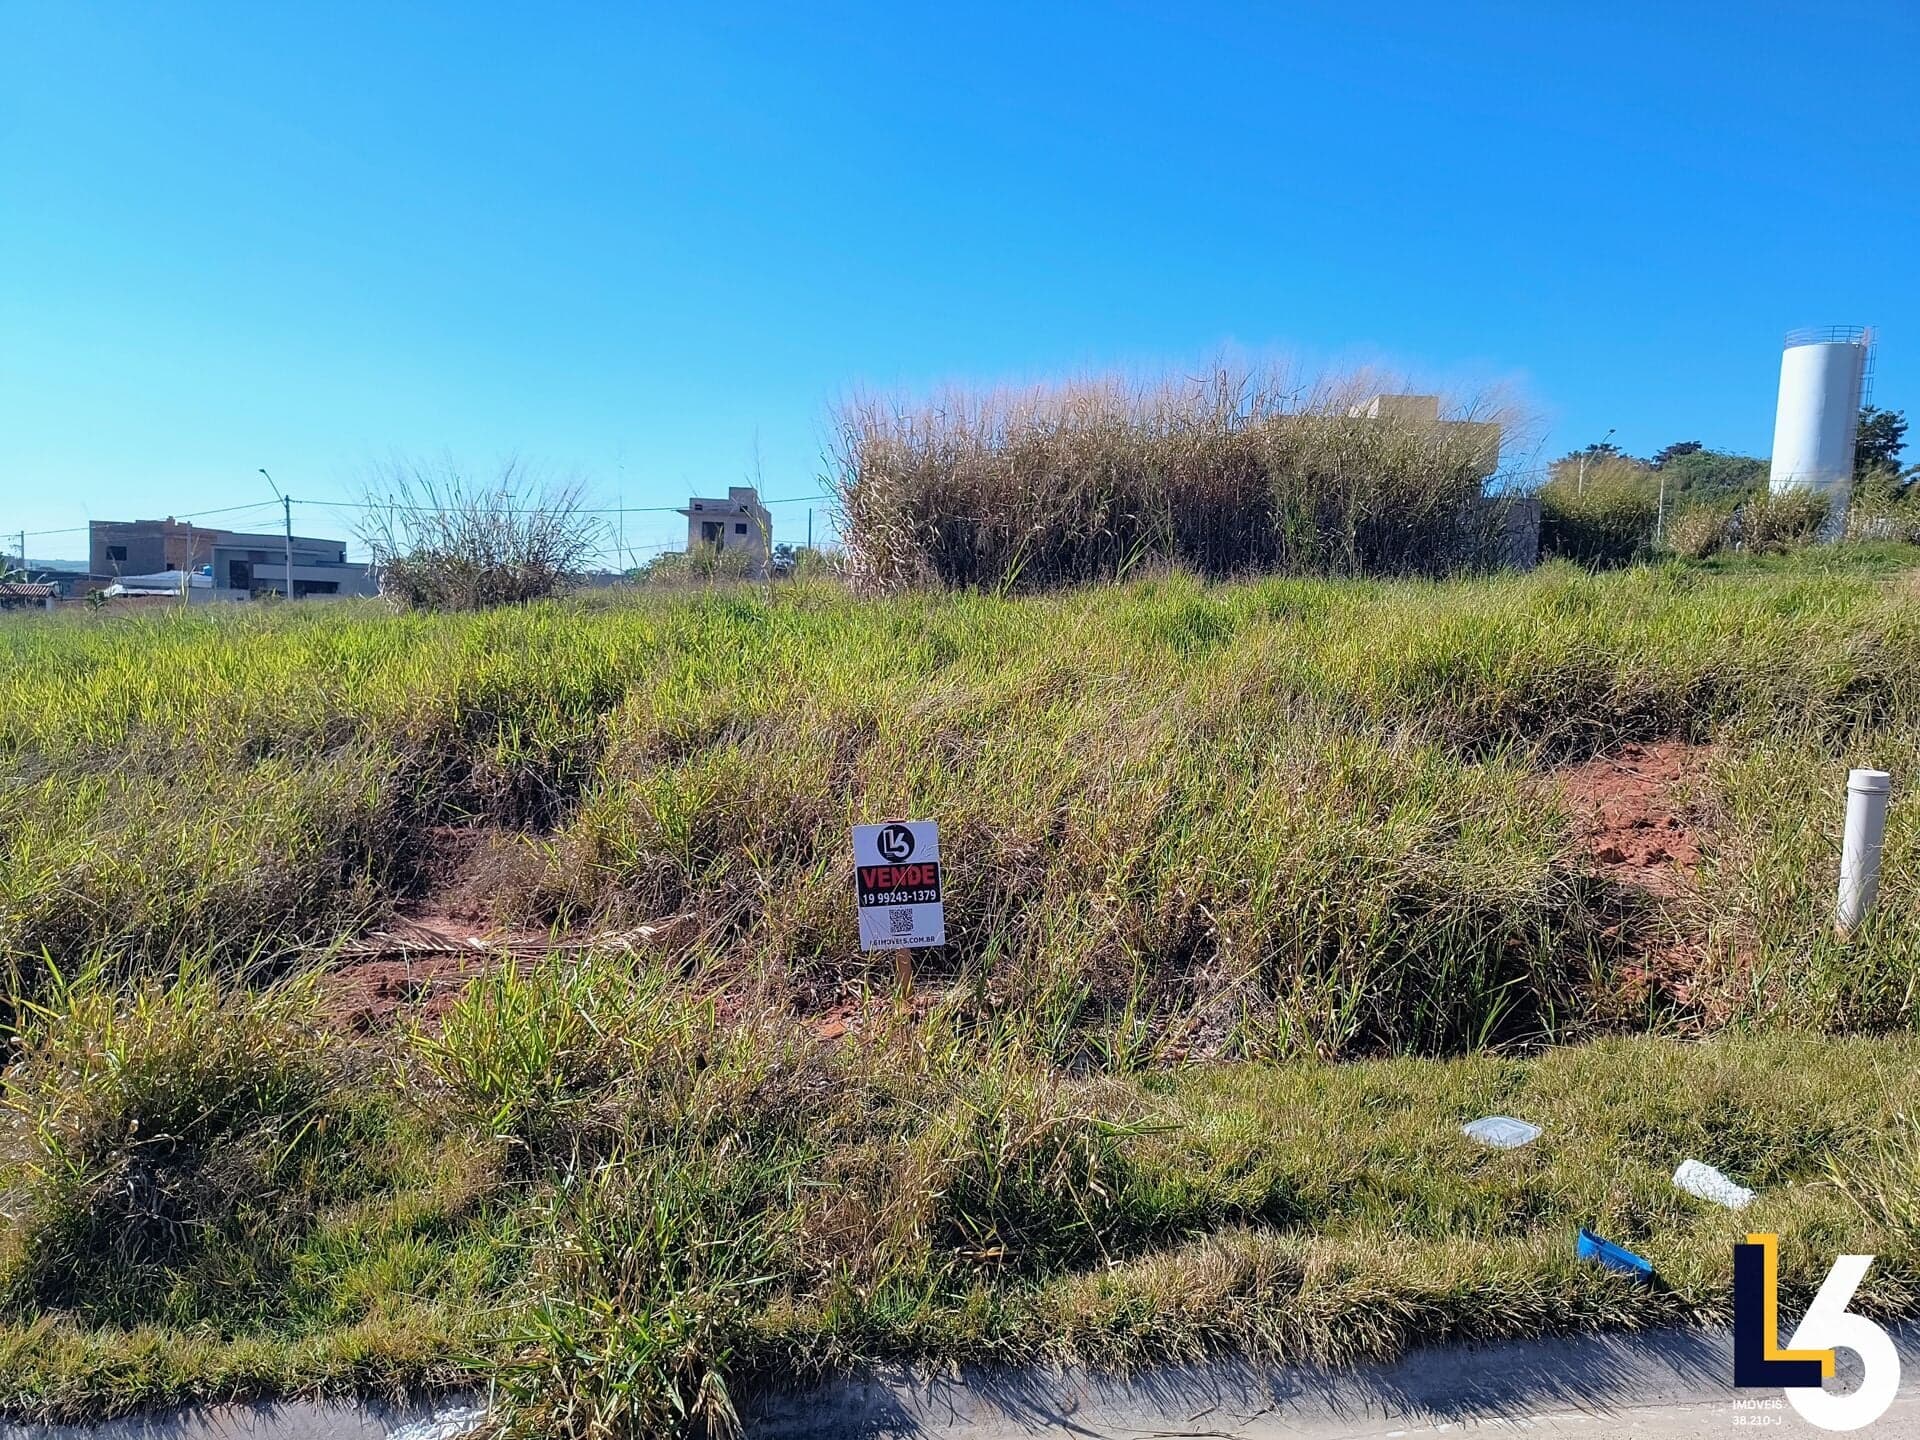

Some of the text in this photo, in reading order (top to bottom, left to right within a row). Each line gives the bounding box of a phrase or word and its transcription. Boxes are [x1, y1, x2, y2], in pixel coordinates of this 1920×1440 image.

[861, 864, 936, 889] VENDE
[863, 889, 937, 905] 19 99243-1379
